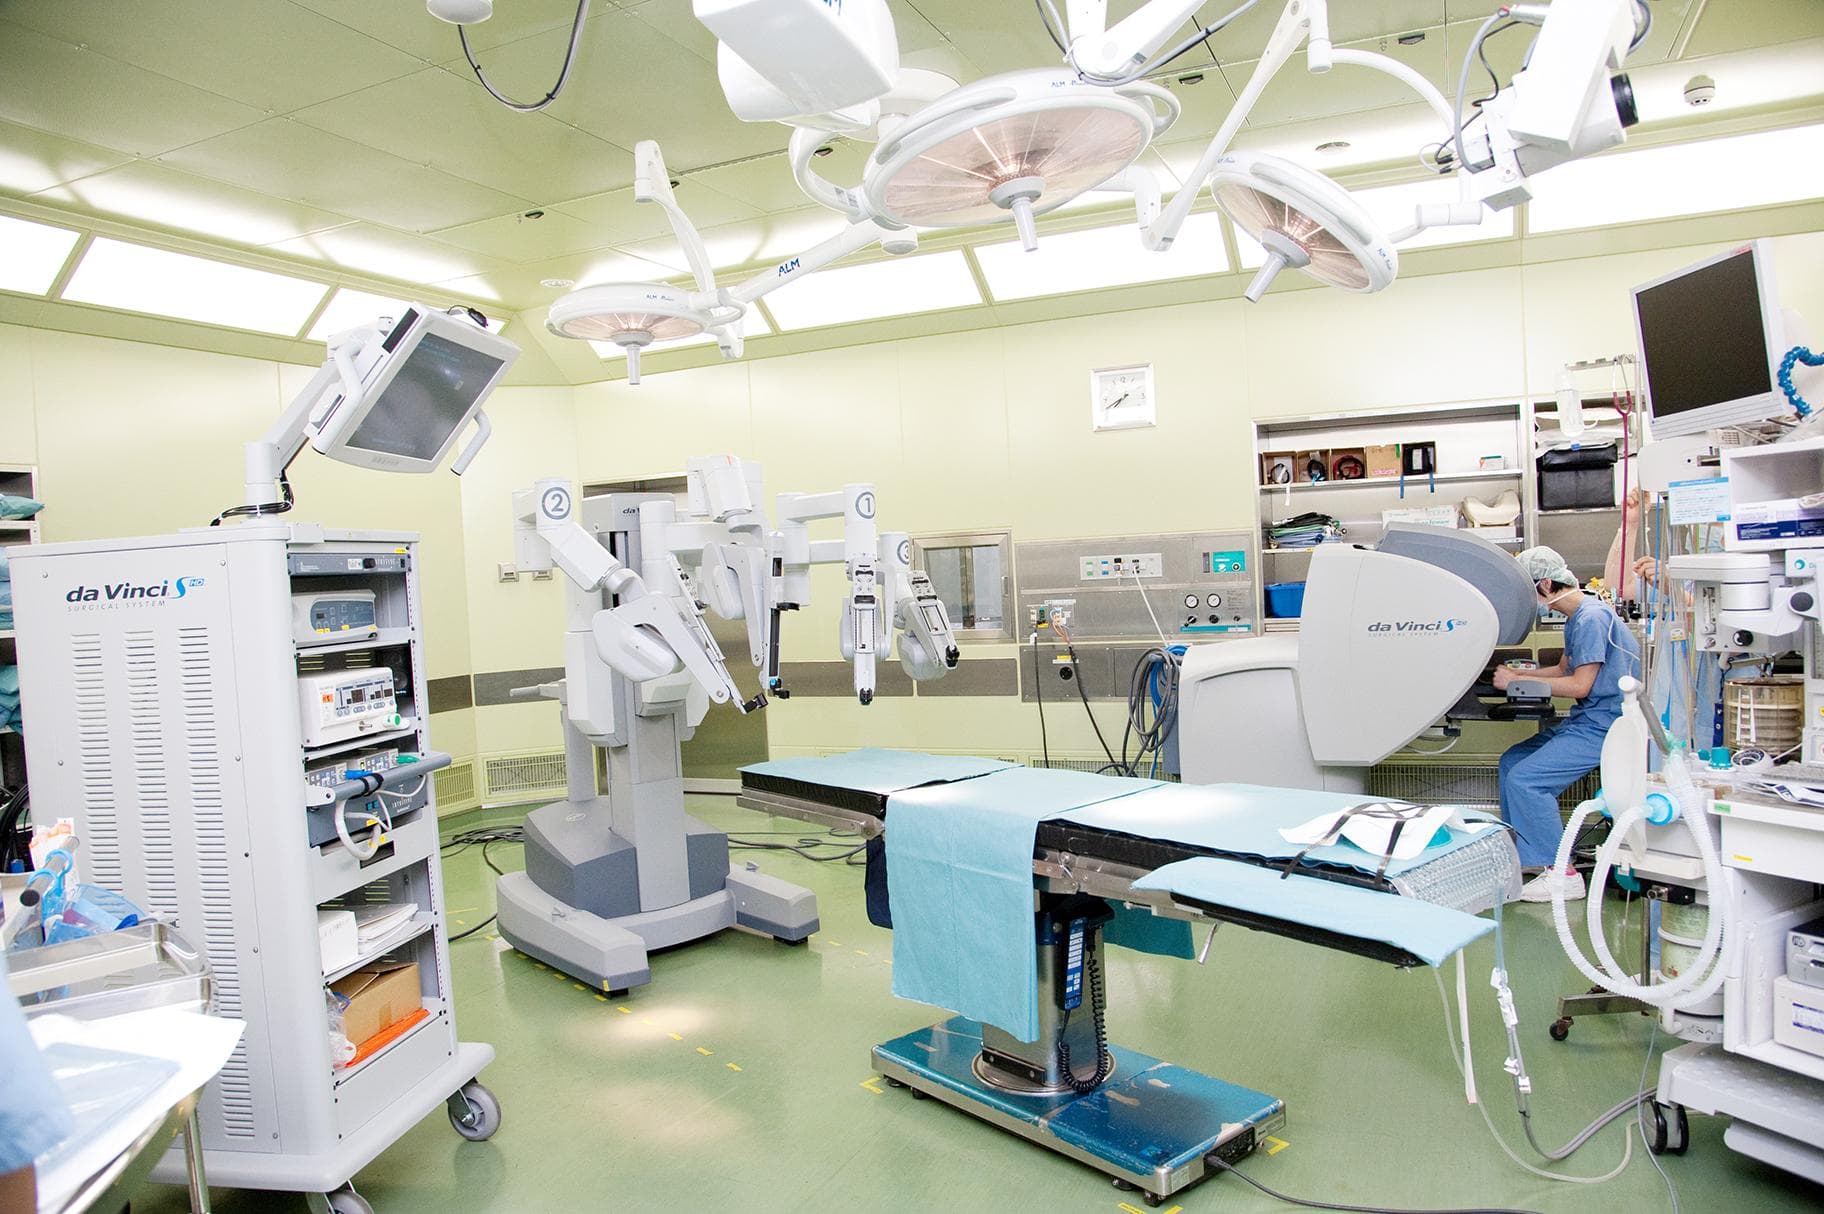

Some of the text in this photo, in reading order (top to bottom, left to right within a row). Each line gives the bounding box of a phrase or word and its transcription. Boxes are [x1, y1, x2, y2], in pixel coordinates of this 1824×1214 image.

[779, 258, 800, 277] ALM
[551, 493, 564, 512] 2
[66, 586, 99, 602] da
[104, 579, 169, 600] Vinci
[67, 600, 166, 612] SURGICAL SYSTEM
[1368, 622, 1392, 632] da
[1395, 620, 1441, 631] Vinci
